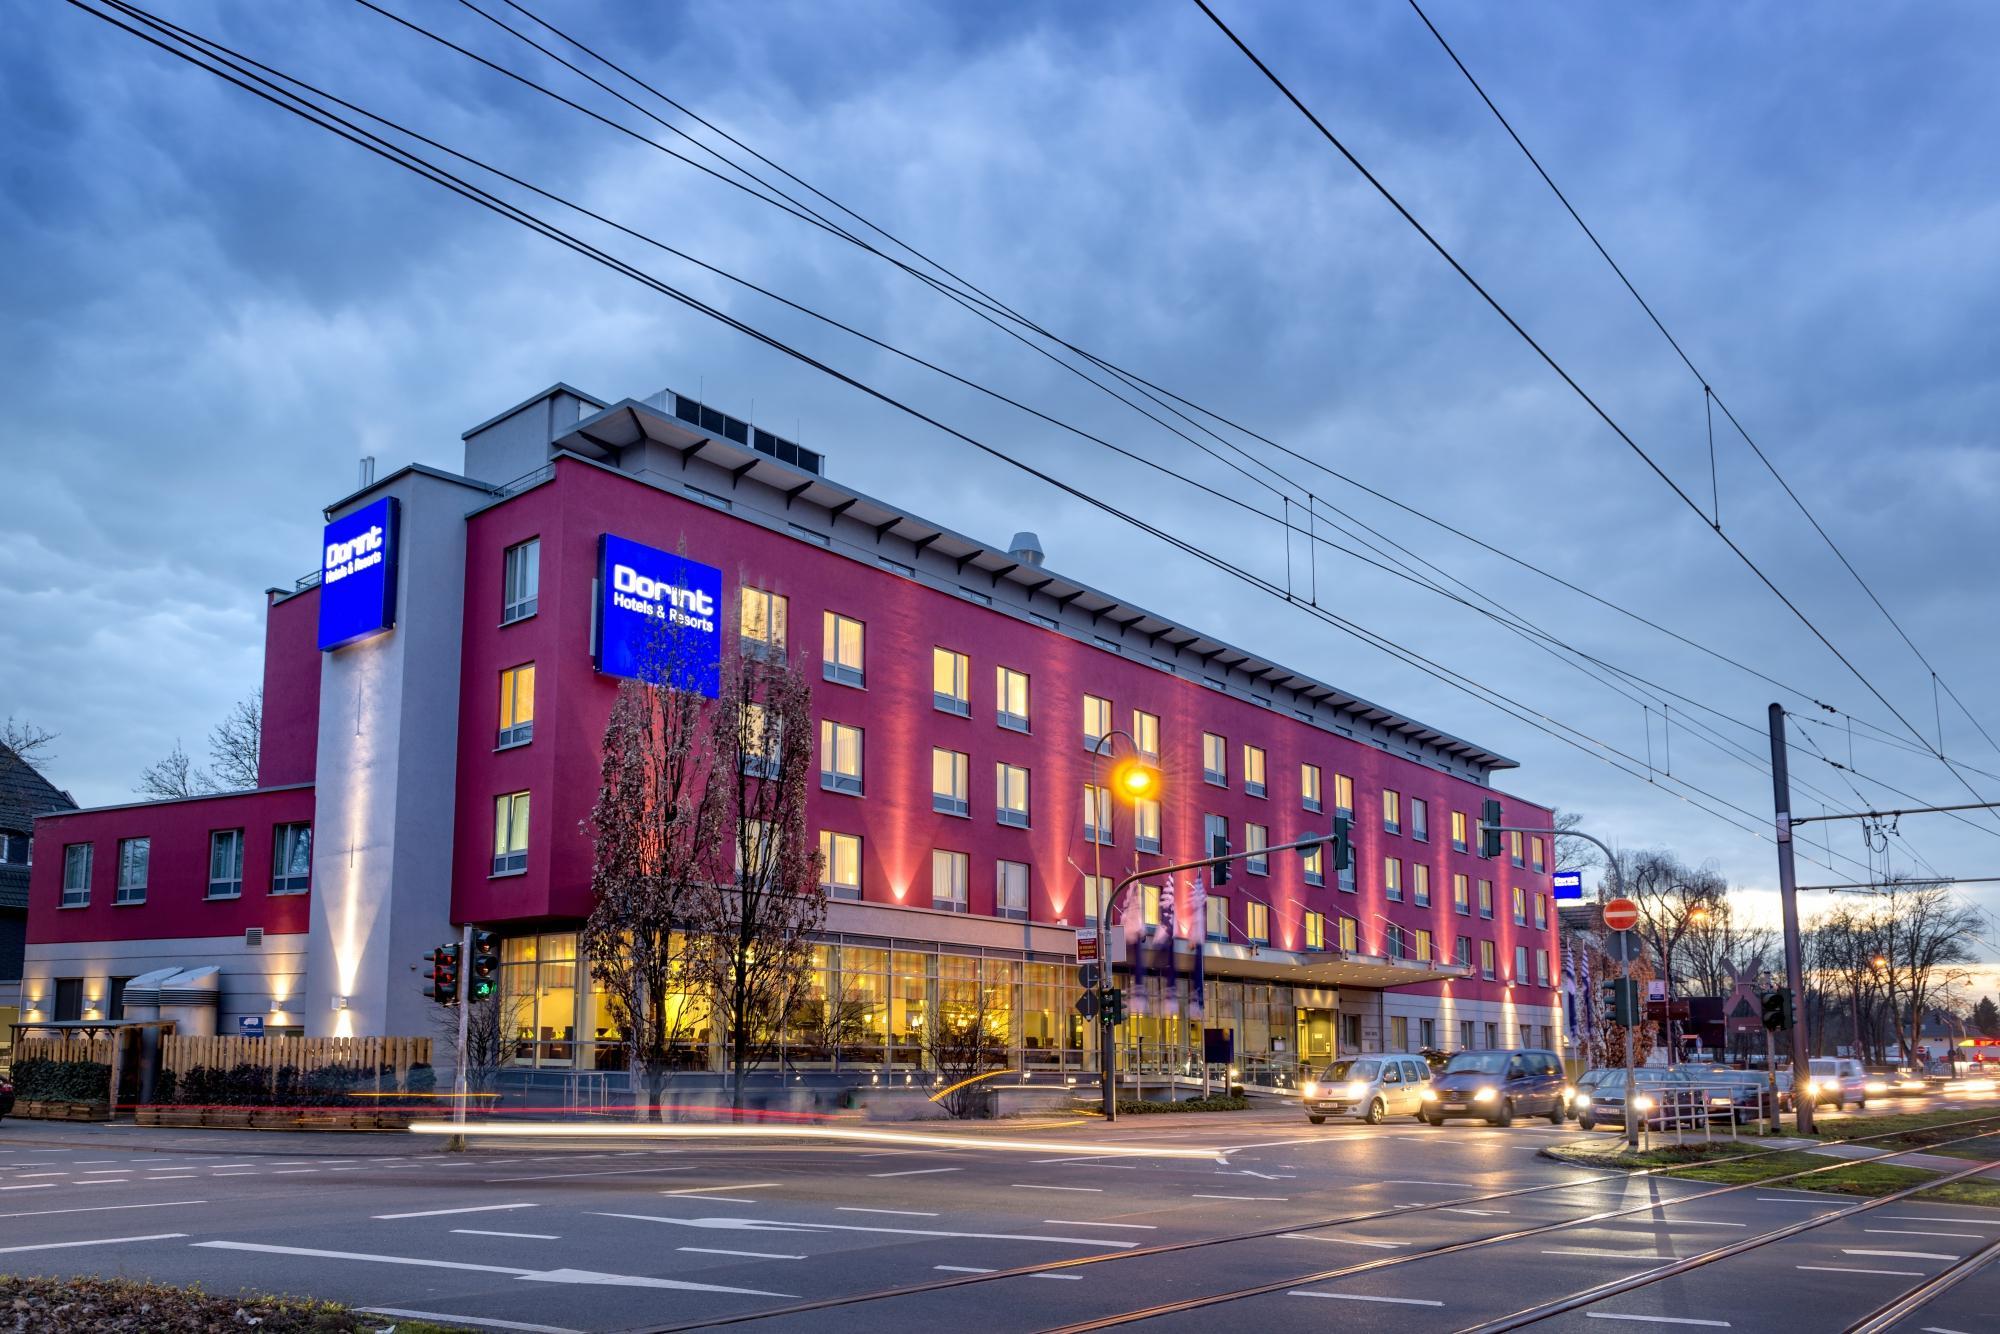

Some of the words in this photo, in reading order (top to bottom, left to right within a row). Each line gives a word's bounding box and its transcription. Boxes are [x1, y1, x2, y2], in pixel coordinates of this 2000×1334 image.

[326, 525, 382, 569] Dorint
[614, 564, 713, 616] Dorint
[614, 592, 653, 615] Hotels
[657, 606, 665, 619] &
[669, 610, 713, 633] Resorts
